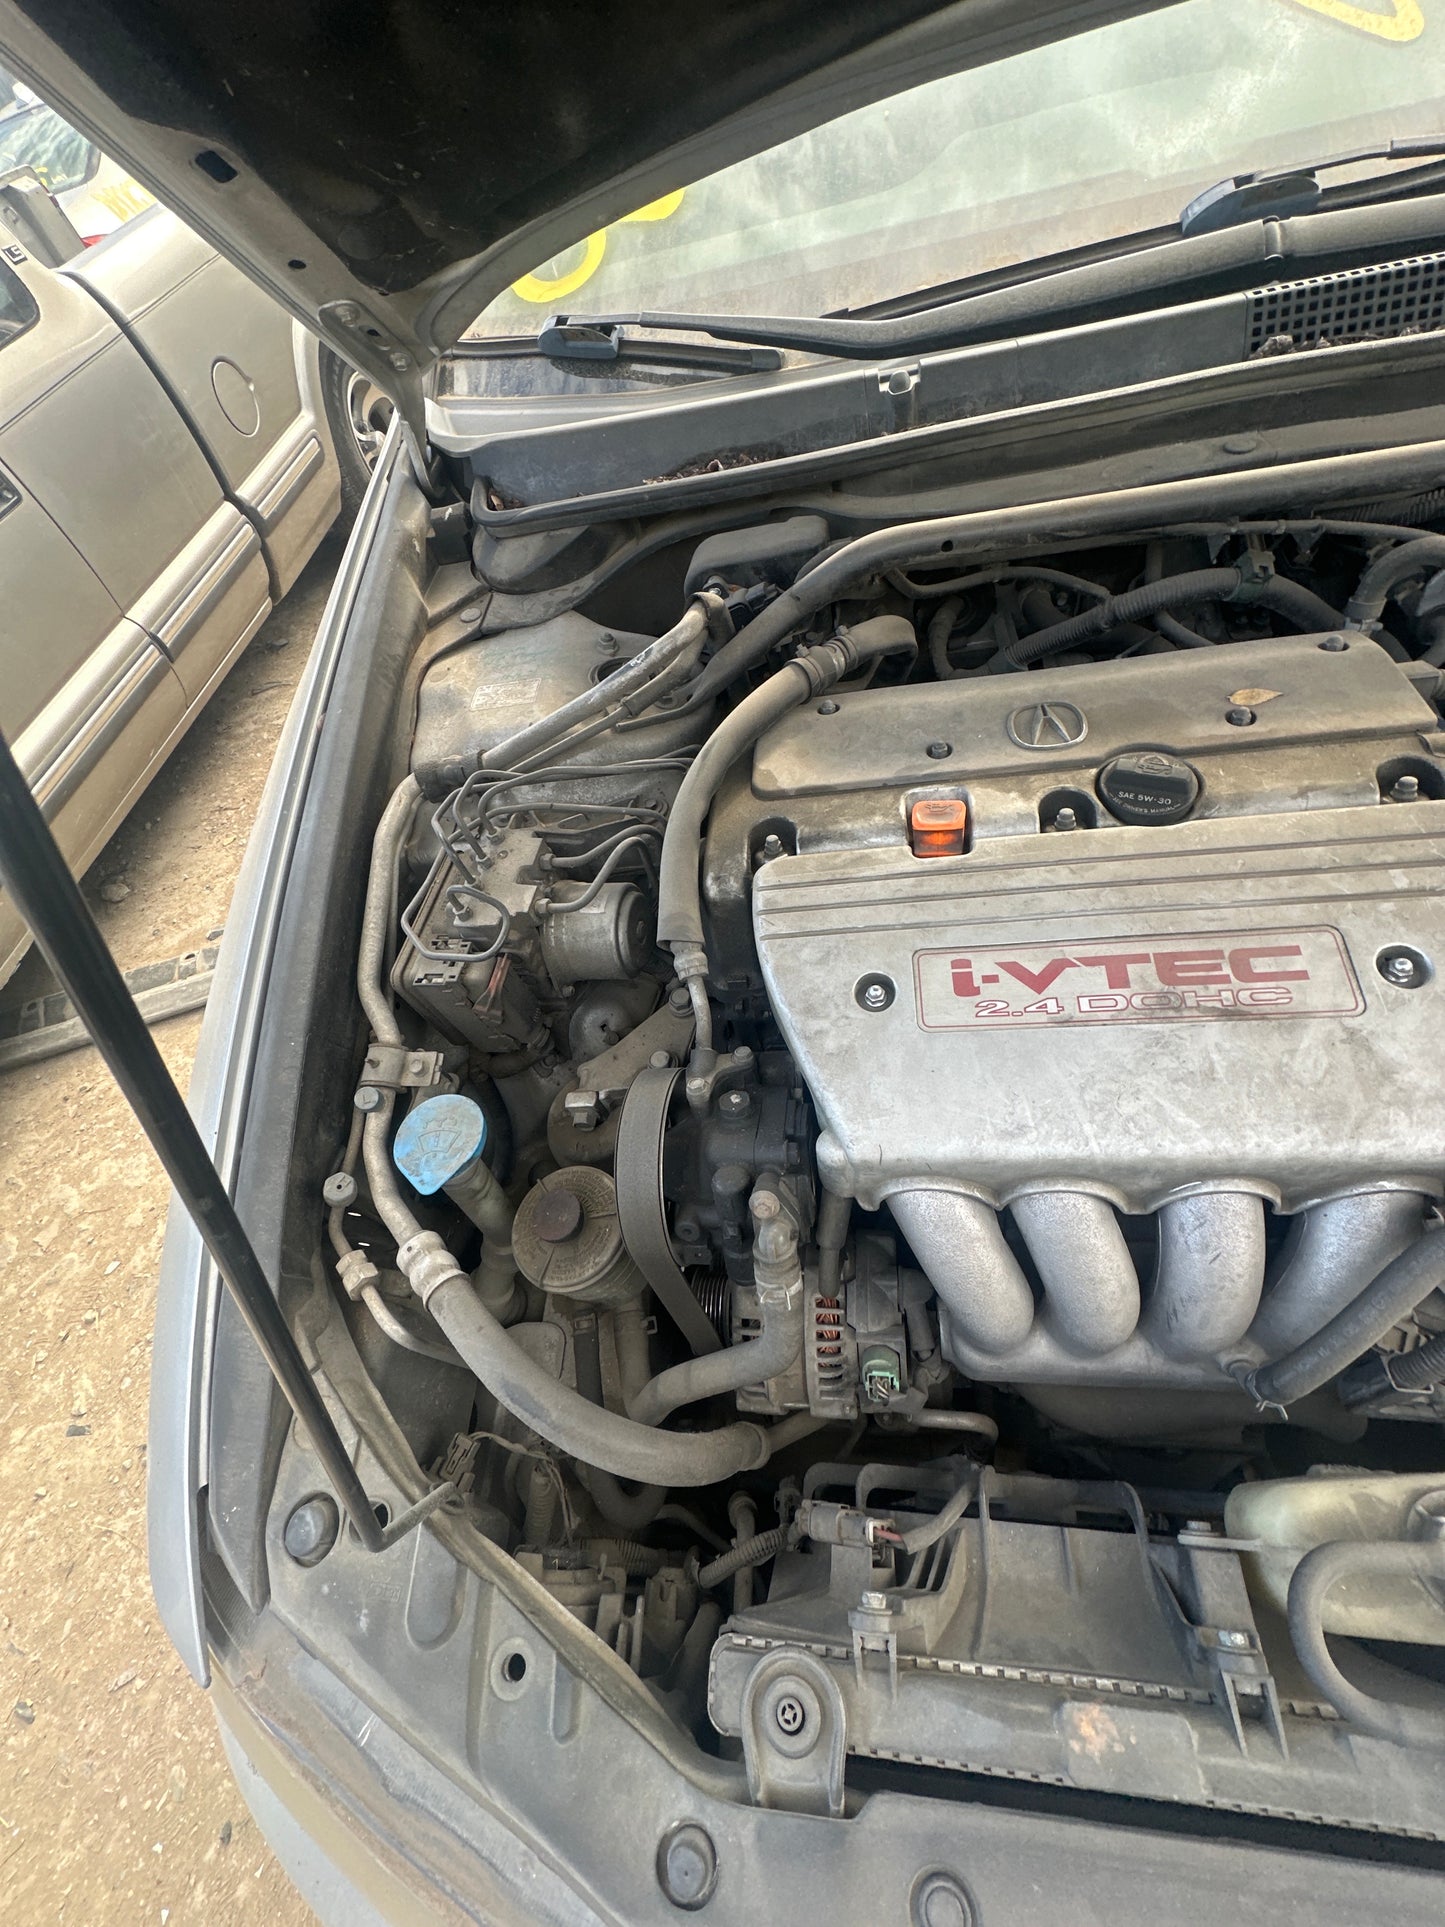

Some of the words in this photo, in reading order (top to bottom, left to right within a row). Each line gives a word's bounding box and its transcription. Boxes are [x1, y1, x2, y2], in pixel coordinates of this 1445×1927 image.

[1118, 791, 1135, 800] SAE
[1137, 794, 1172, 805] 5W-30
[950, 945, 1310, 997] i-VTEC
[975, 997, 1064, 1018] 2.4
[1077, 986, 1293, 1013] DOHC
